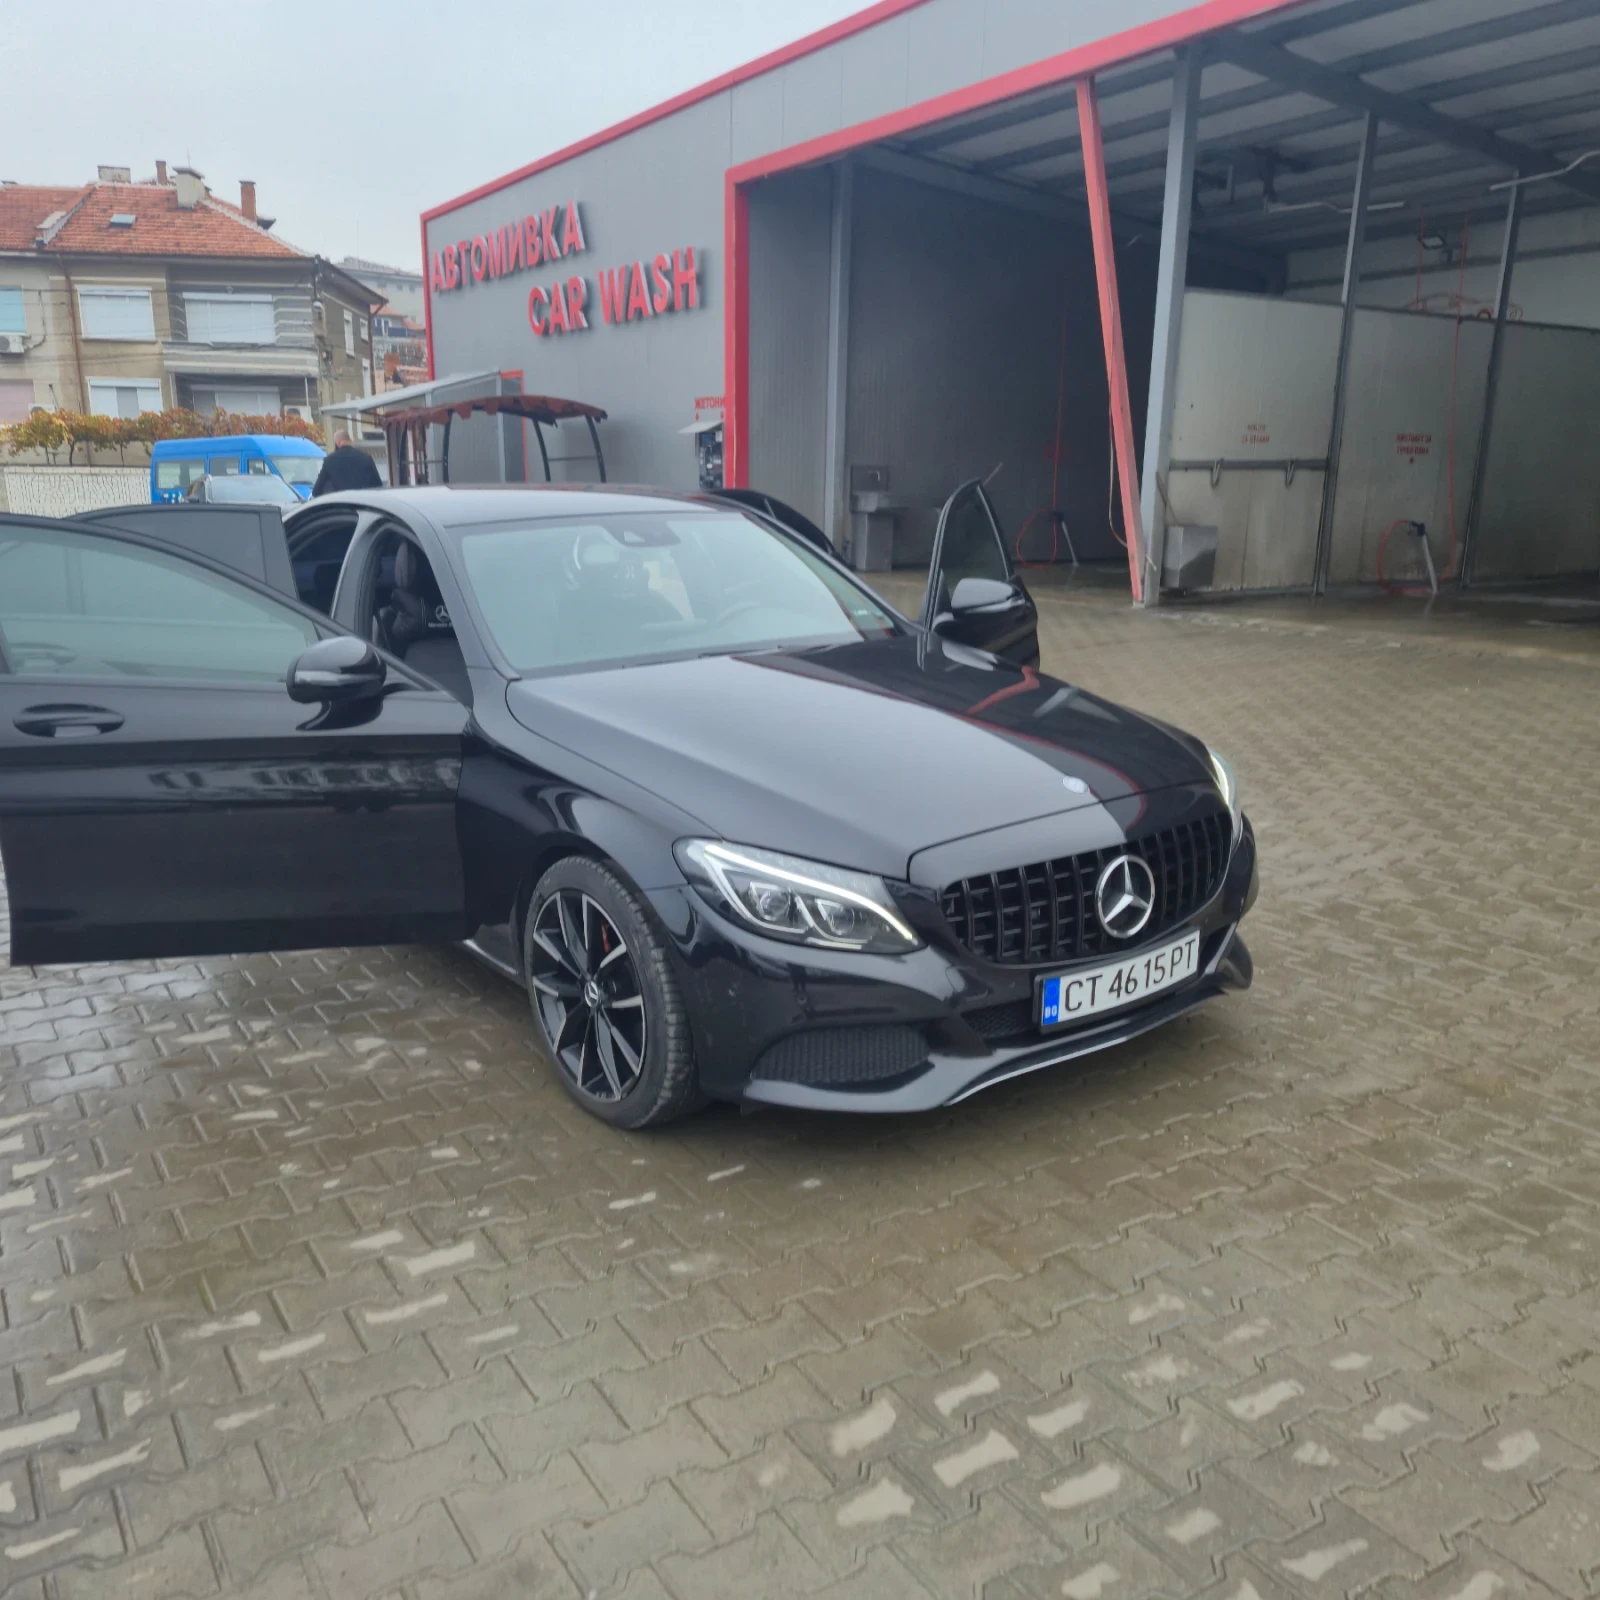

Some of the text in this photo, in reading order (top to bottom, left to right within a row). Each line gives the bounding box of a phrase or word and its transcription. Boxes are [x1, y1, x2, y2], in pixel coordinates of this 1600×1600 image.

[431, 200, 585, 293] АВТОМИВКА
[528, 246, 697, 336] CAR WASH
